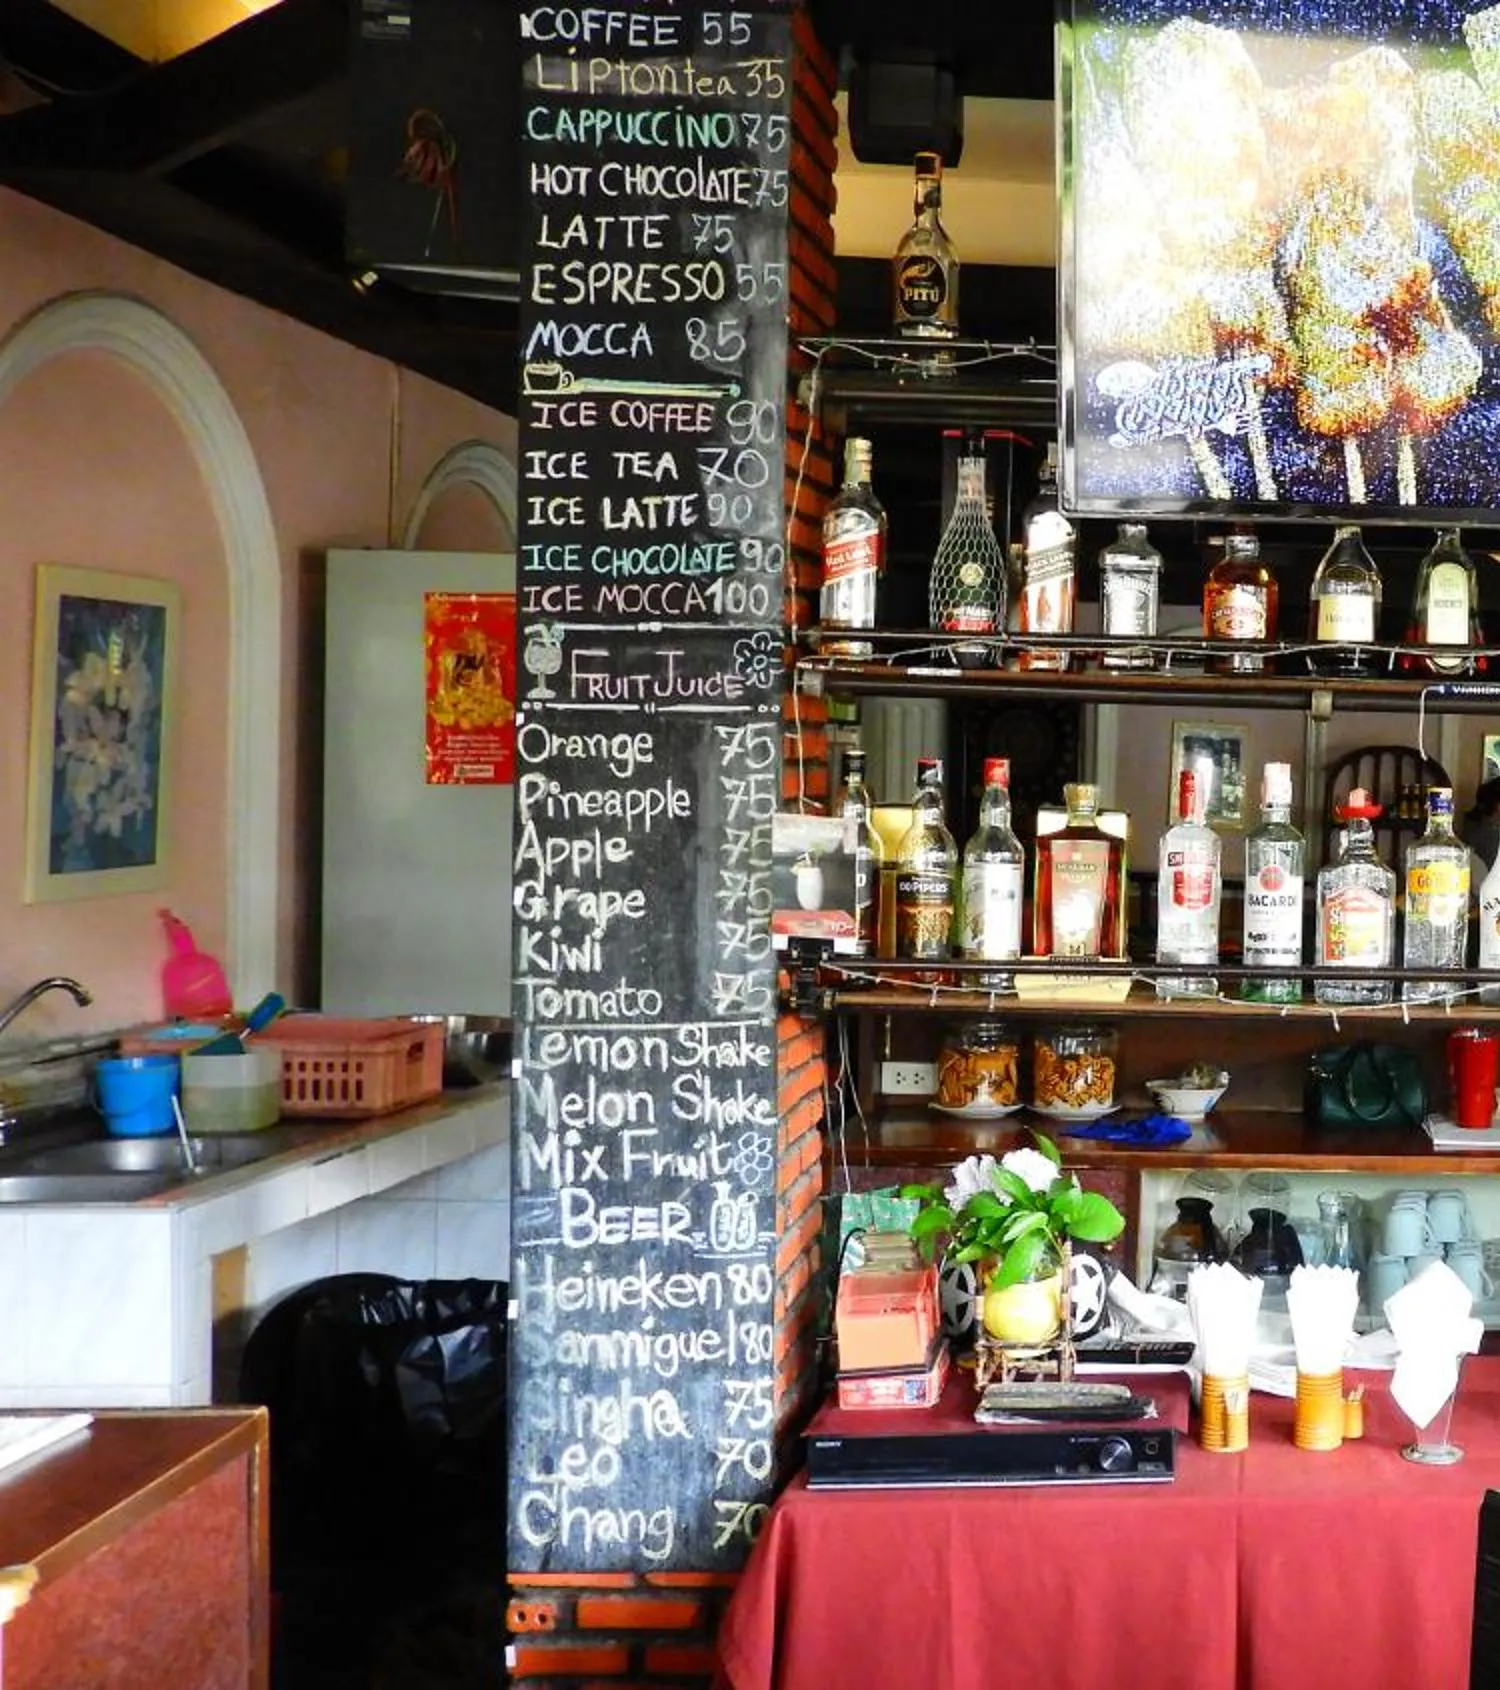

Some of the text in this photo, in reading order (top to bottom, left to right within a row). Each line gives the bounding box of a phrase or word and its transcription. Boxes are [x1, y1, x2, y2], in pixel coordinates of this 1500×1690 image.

[530, 8, 752, 47] COFFEE 55
[736, 59, 785, 99] 35
[741, 114, 789, 152] 75
[530, 156, 789, 207] HOT CHOCOLATE 75
[537, 213, 736, 252] LATTE 75
[531, 260, 785, 304] ESPRESSO 55
[526, 317, 746, 361] MOCCA 85
[530, 400, 778, 445] ICE COFFEE 90
[525, 448, 769, 488] ICE TEA 70
[527, 493, 752, 530] ICE LATTE 90
[522, 539, 785, 578] ICE CHOCOLATE 90
[522, 577, 769, 615] ICE MOCCA 100
[571, 649, 744, 699] FRUIT JUICE
[517, 723, 654, 778] Orange
[714, 722, 777, 769] 75
[519, 772, 778, 833] Pineapple 75
[515, 819, 773, 880] Apple 75
[514, 870, 773, 932] Grape 75
[519, 918, 772, 973] Kiwi 75
[513, 969, 772, 1021] Tomato 75
[523, 1021, 772, 1073] Lemon Shake
[518, 1070, 778, 1130] Melon Shake
[519, 1128, 733, 1190] Mix Fruit
[560, 1187, 692, 1247] BEER
[517, 1253, 773, 1330] Heineken 80
[739, 1322, 773, 1365] 80
[522, 1375, 774, 1445] Singha 75
[527, 1438, 773, 1490] Leo 70
[517, 1480, 675, 1560] Chang
